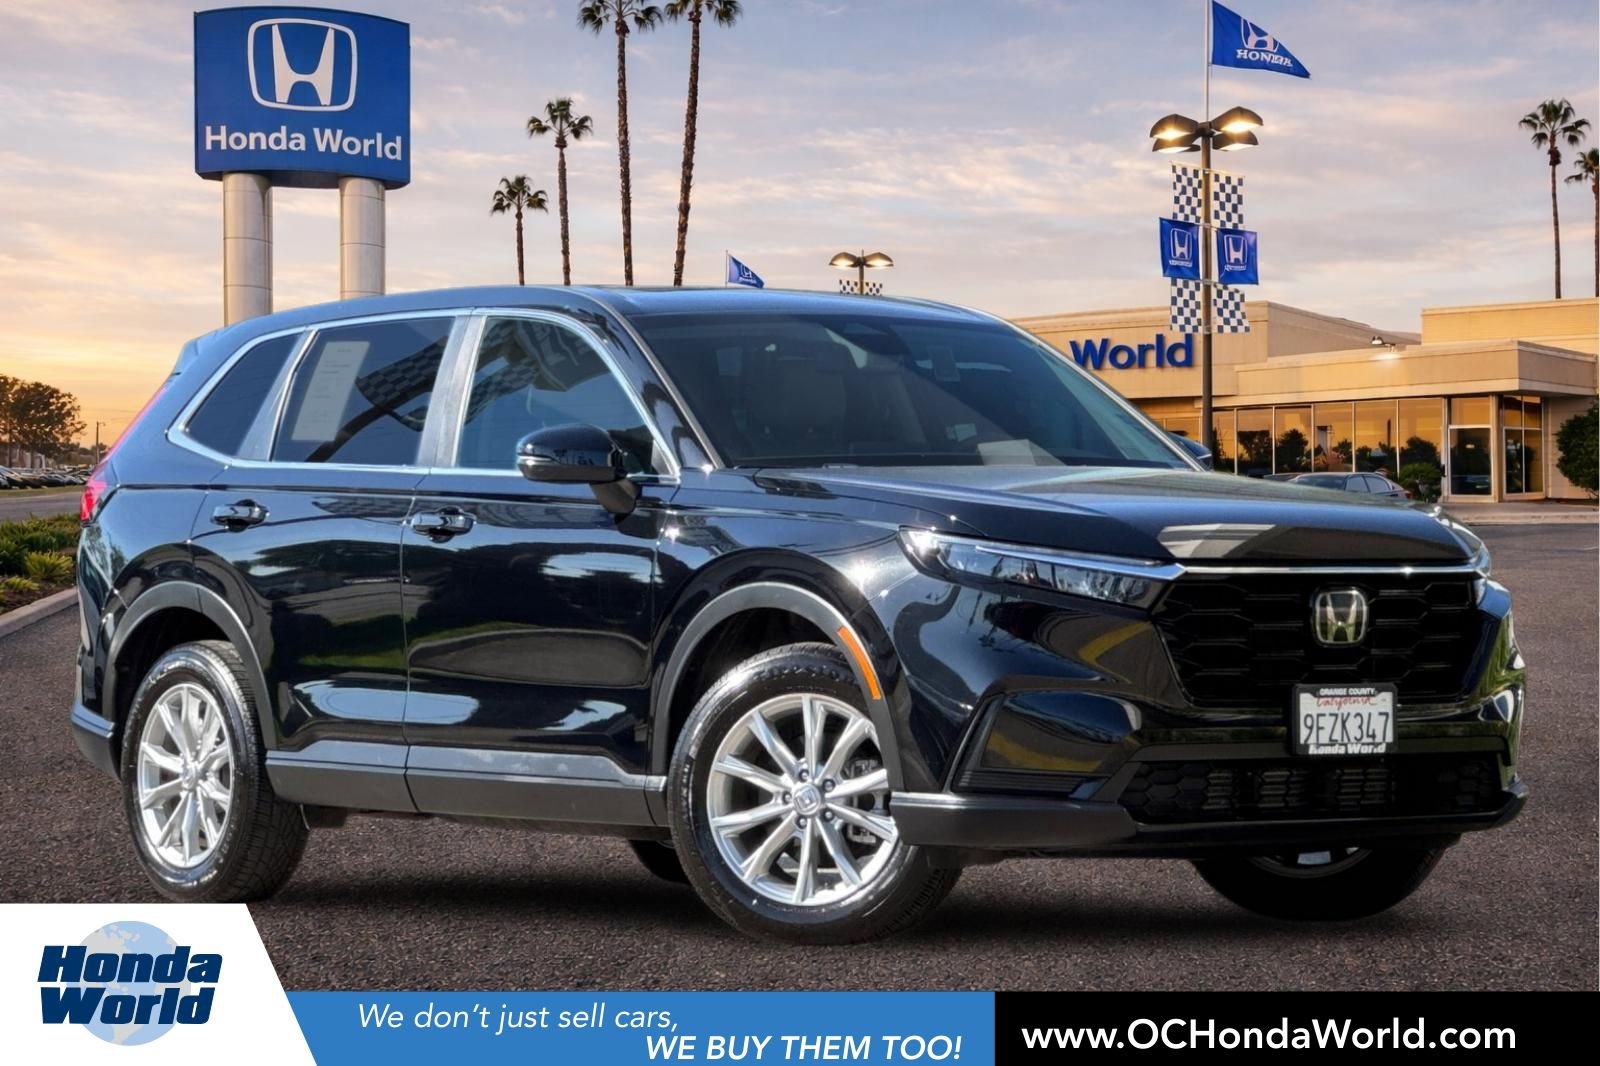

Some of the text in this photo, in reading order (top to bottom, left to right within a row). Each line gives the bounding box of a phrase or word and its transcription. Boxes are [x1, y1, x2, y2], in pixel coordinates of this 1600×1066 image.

[205, 125, 402, 160] Honda World
[1069, 333, 1194, 370] World
[1348, 687, 1376, 696] COUNTY
[1303, 712, 1390, 744] 9FZK347
